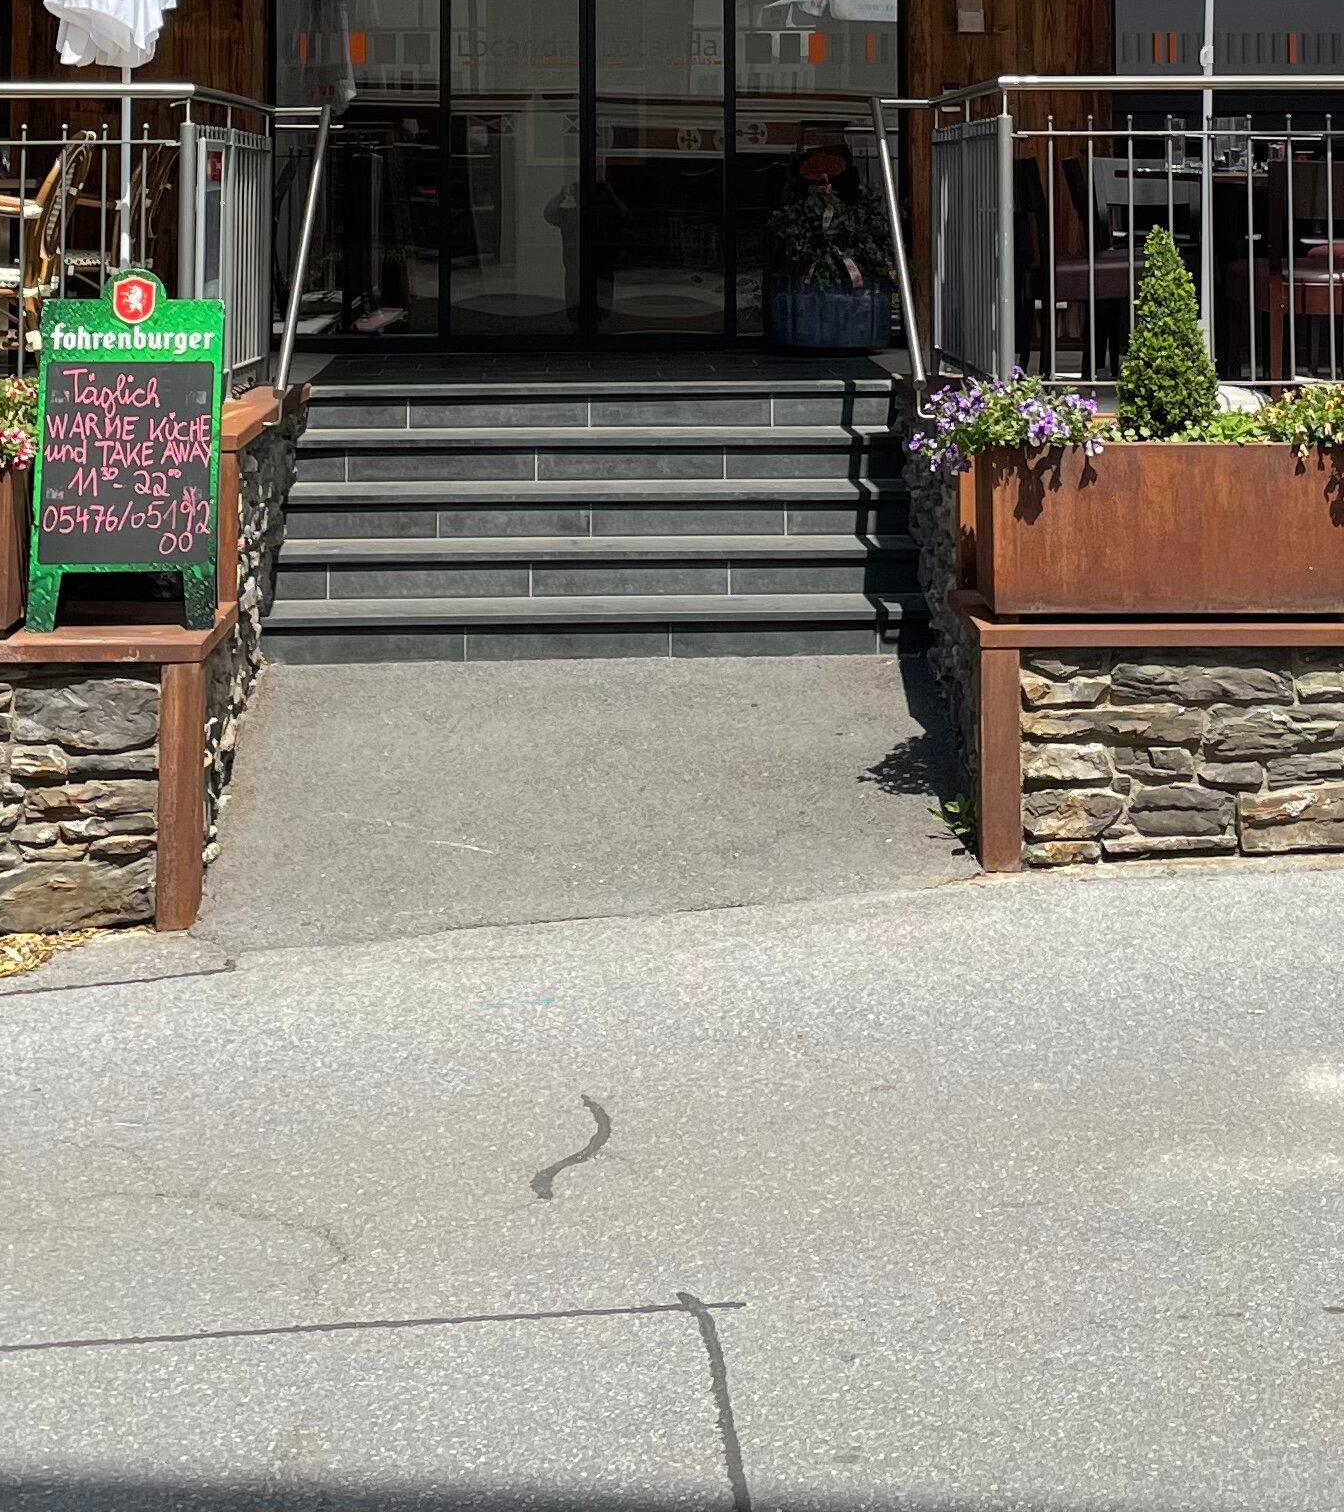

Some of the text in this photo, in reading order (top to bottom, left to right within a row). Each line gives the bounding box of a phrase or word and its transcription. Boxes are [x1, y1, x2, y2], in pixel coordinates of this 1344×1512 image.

[62, 368, 161, 419] Täglich
[46, 411, 212, 443] WARME KÜCHE
[44, 439, 213, 469] und TAKE AWAY
